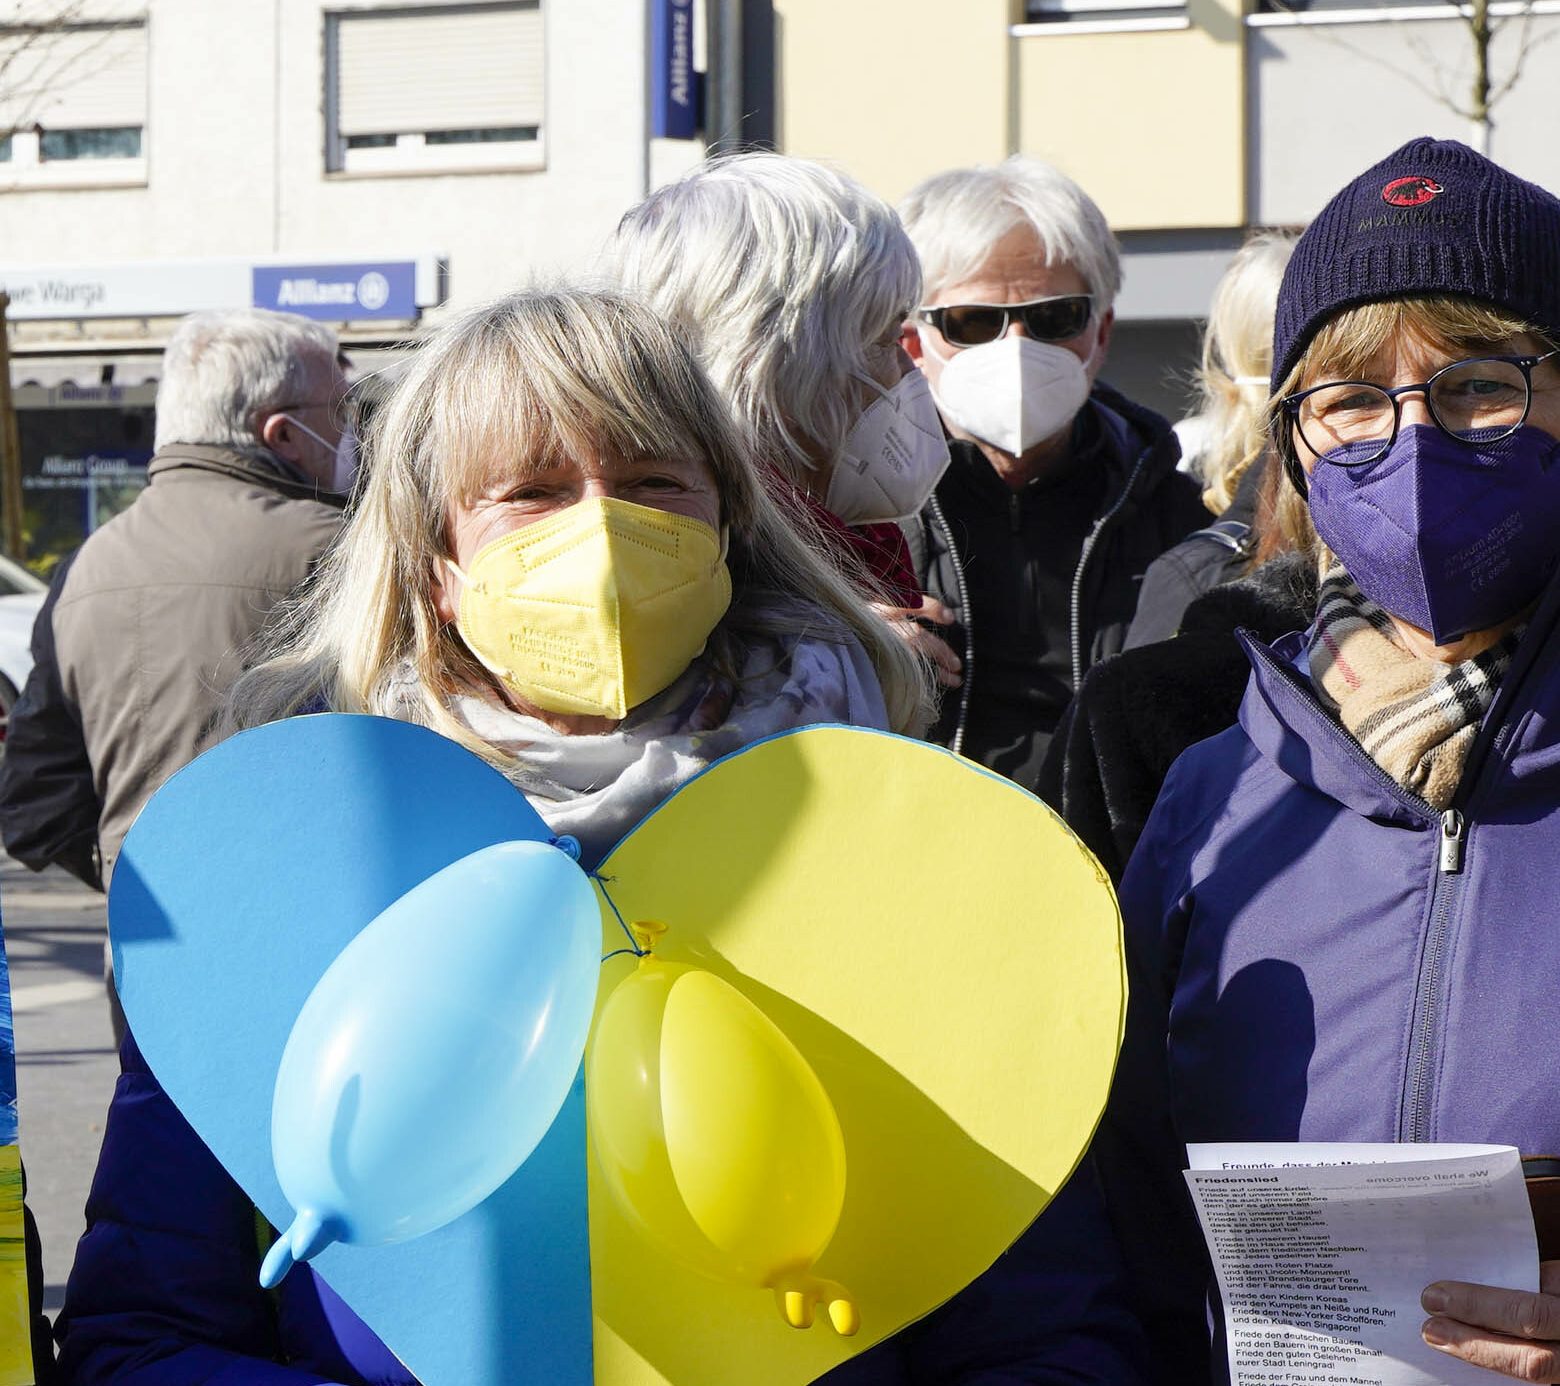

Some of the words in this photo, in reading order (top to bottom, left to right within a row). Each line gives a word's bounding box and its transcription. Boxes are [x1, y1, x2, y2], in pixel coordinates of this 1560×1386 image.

[670, 11, 688, 107] Allianz
[277, 278, 356, 306] Allianz
[1269, 1301, 1308, 1310] Kumpels
[1232, 1307, 1261, 1315] Friede
[1281, 1310, 1333, 1319] New-Yorker
[1234, 1330, 1262, 1338] Friede
[1283, 1333, 1331, 1342] deutschen
[1332, 1336, 1364, 1345] Bauern
[1320, 1346, 1352, 1354] großen
[1285, 1351, 1311, 1359] guten
[1313, 1352, 1356, 1362] Gelehrten
[1262, 1359, 1286, 1367] Stadt
[1285, 1373, 1306, 1381] Frau
